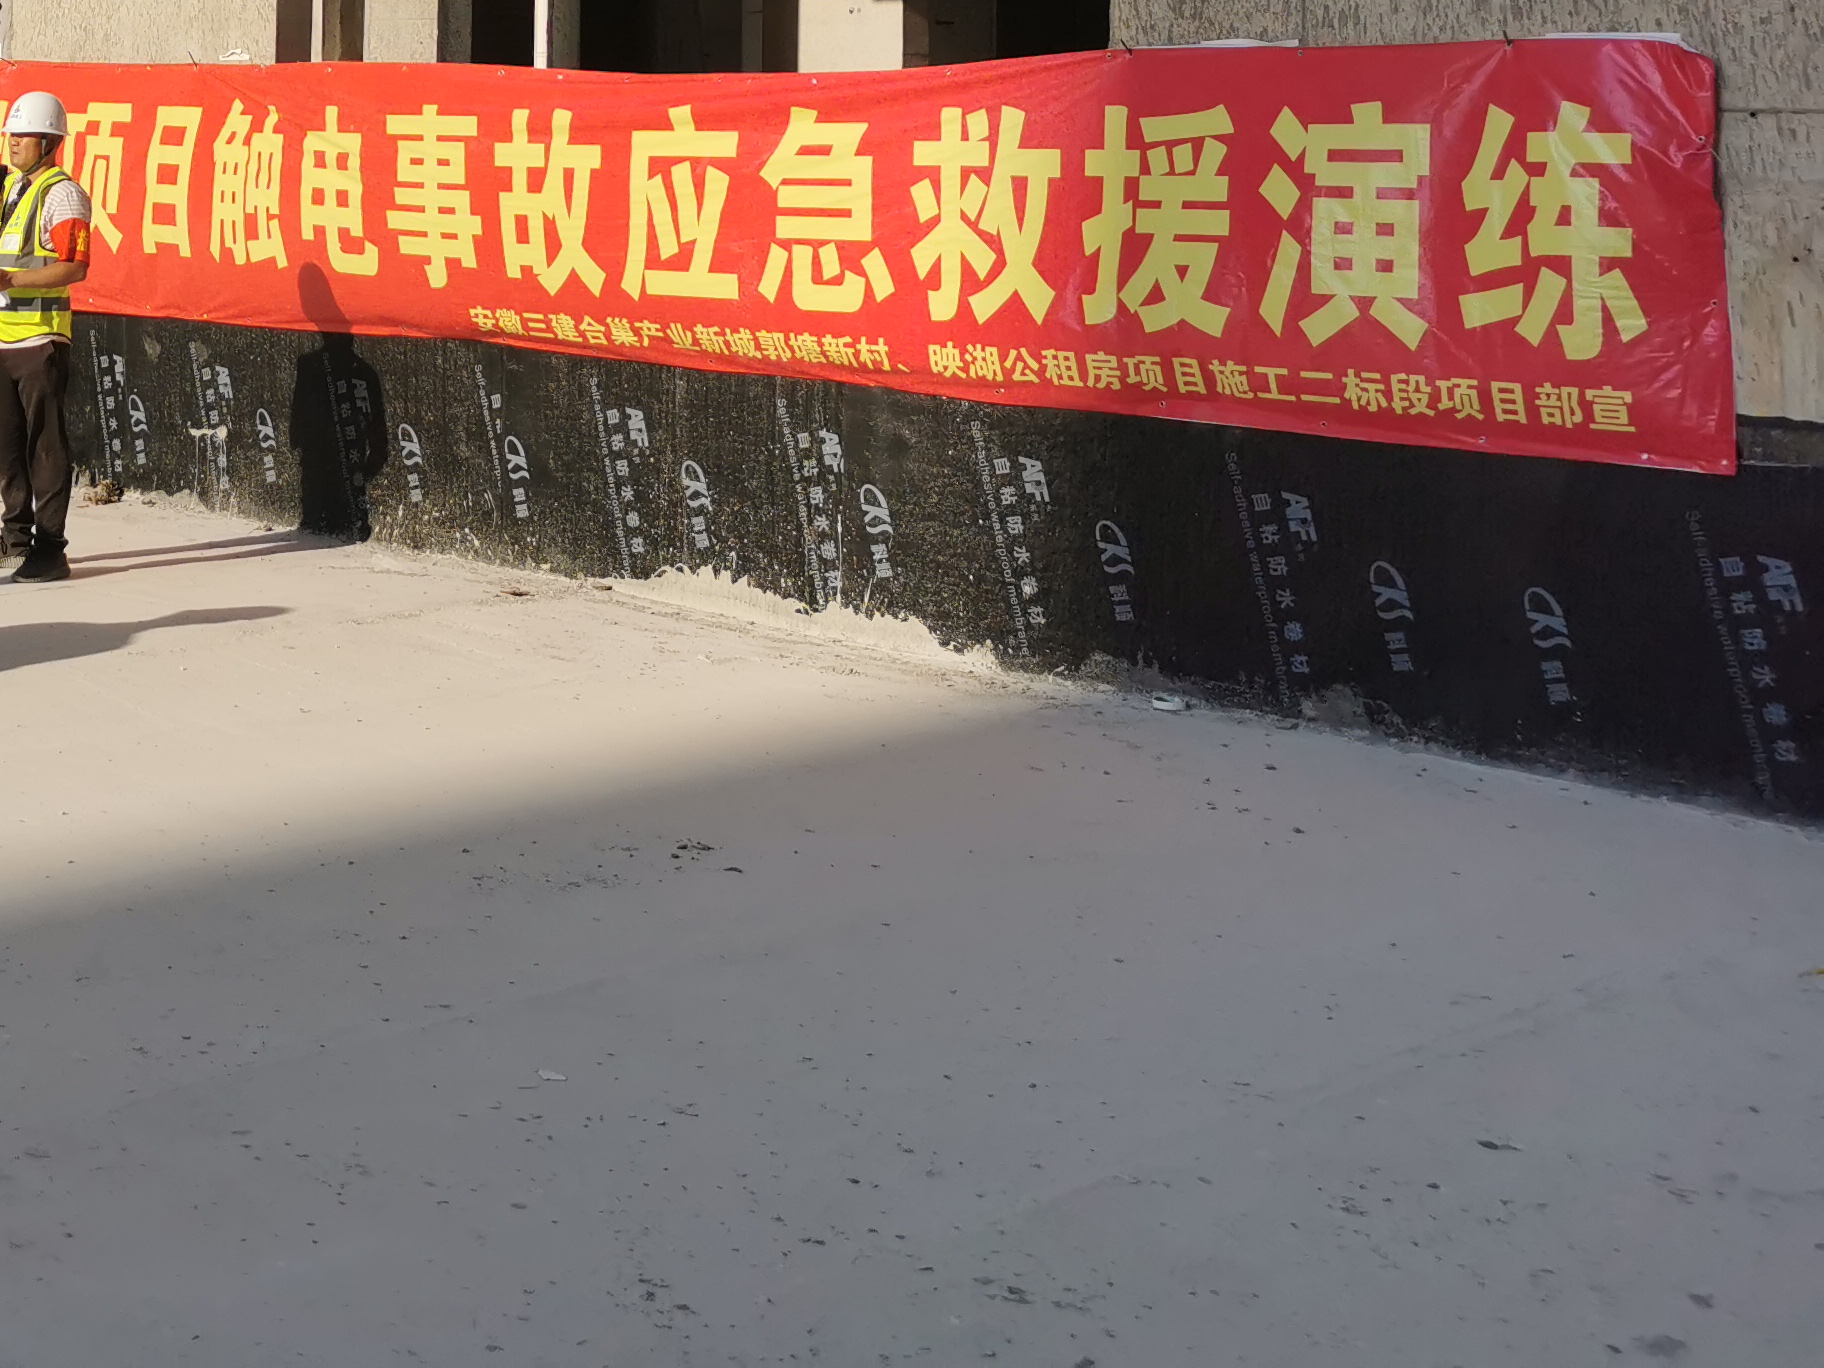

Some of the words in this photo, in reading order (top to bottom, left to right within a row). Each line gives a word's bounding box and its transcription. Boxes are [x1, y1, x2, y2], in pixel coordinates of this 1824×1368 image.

[469, 306, 1636, 432] 安徽三建合巢产业新城郭塘新村、映湖公租房项目施工二标段项目部宣
[128, 394, 151, 434] CKS
[256, 408, 276, 448] CKS
[398, 423, 423, 467] CKS
[504, 435, 530, 480] CKS
[606, 409, 645, 554] 自粘防水卷材
[681, 460, 712, 510] CKS
[859, 483, 894, 535] CKS
[971, 421, 996, 509] Self-adhesive
[992, 511, 1015, 584] waterproof
[1006, 585, 1029, 655] membrane
[993, 458, 1046, 624] 自粘防水卷材
[1095, 520, 1135, 575] CKS
[1251, 492, 1310, 673] 自粘防水卷材
[1369, 560, 1414, 622] CKS
[1523, 586, 1572, 649] CKS
[1719, 556, 1798, 763] 自粘防水卷材
